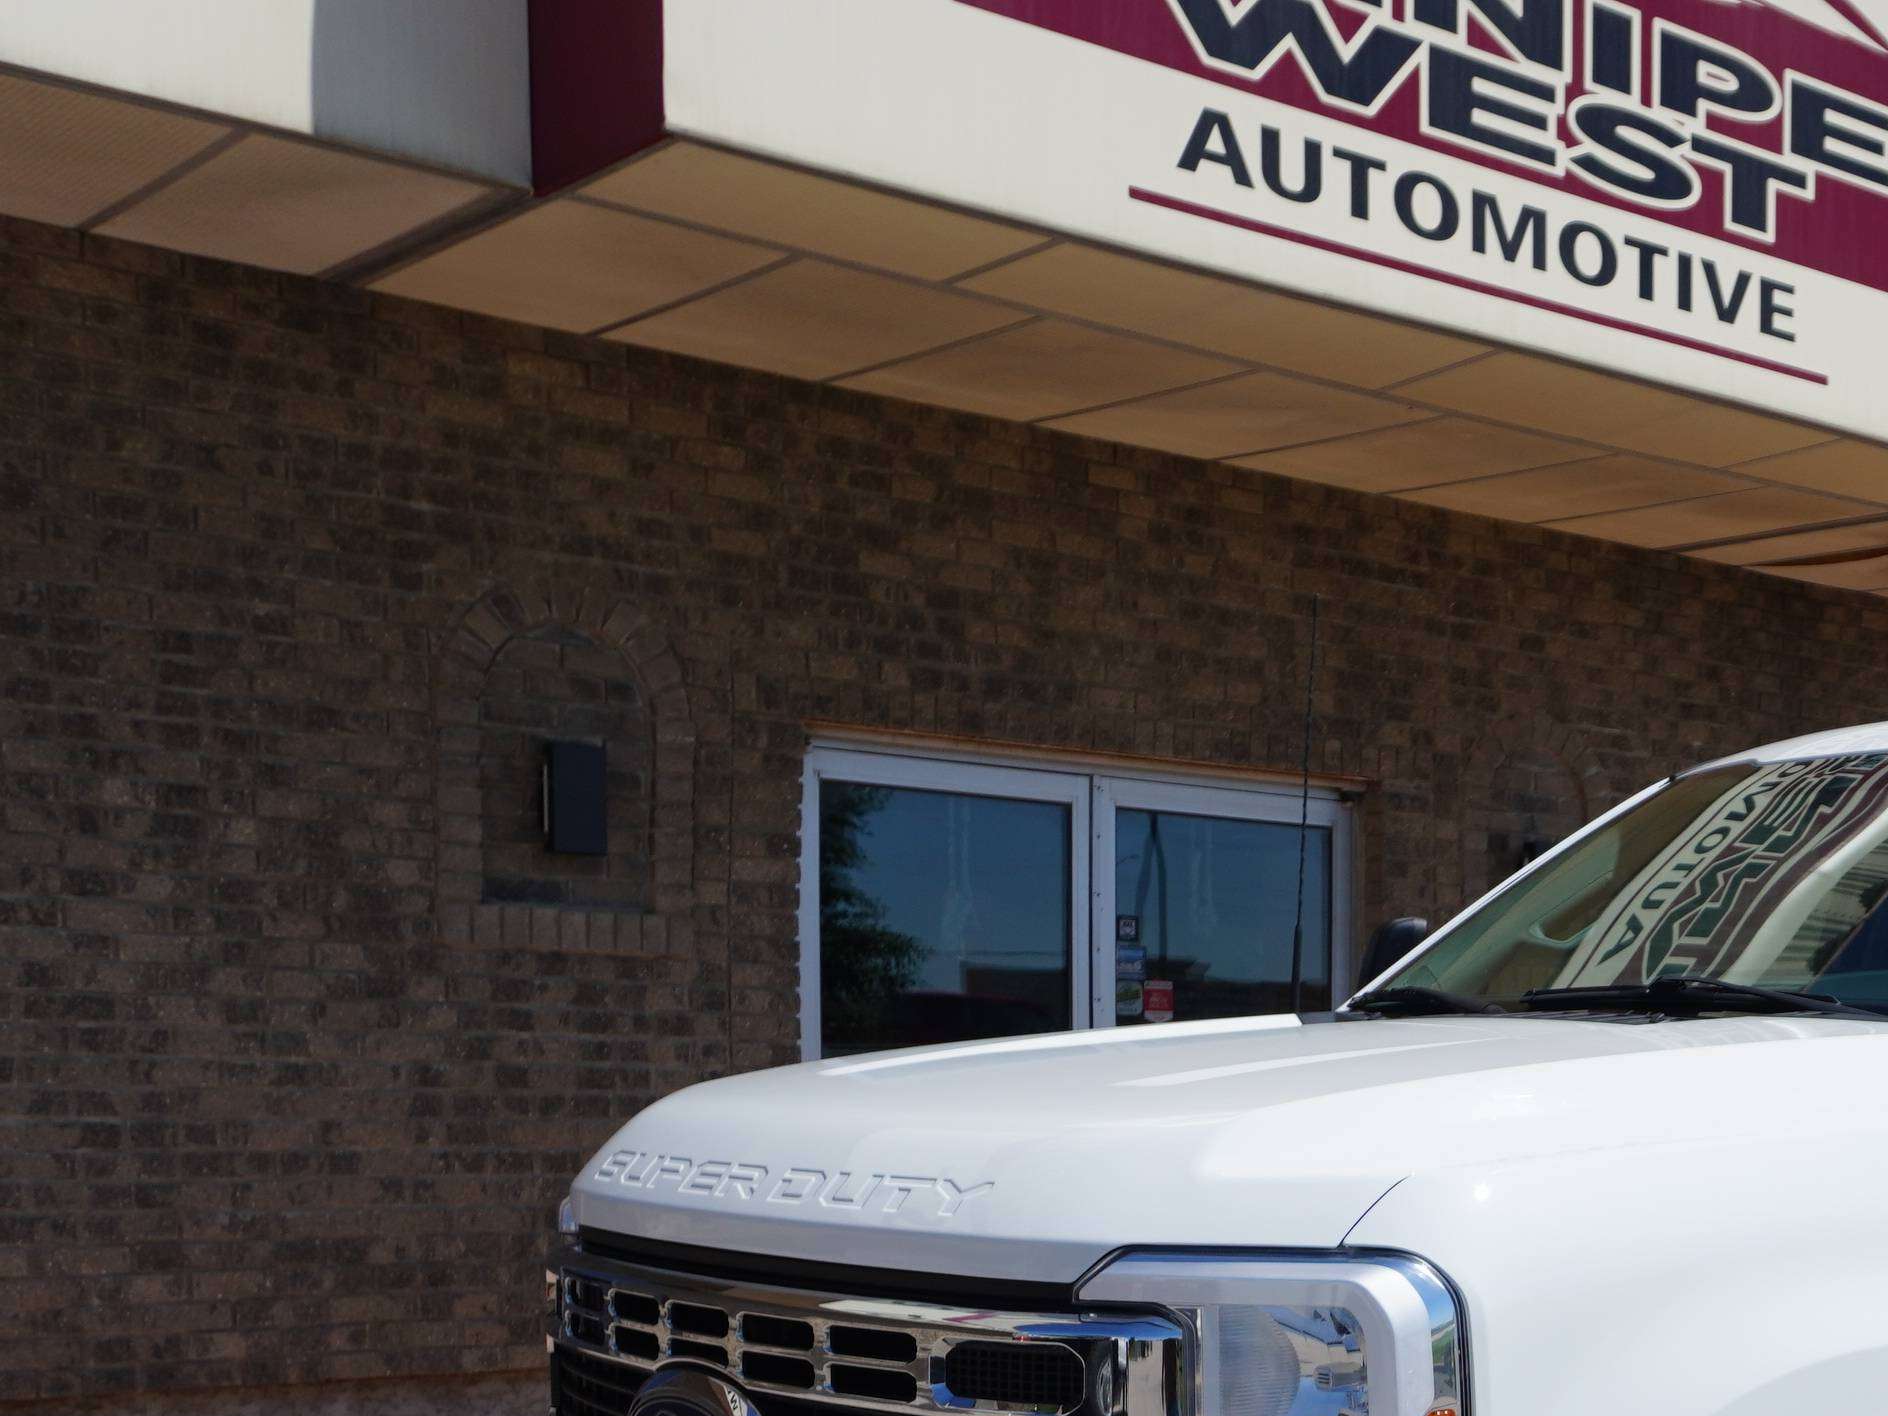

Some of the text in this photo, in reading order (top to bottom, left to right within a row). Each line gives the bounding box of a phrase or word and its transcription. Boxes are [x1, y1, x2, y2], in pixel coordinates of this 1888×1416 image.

[1172, 0, 1810, 233] WEST
[1177, 106, 1796, 343] AUTOMOTIVE
[595, 1149, 996, 1217] SUPER DUTY
